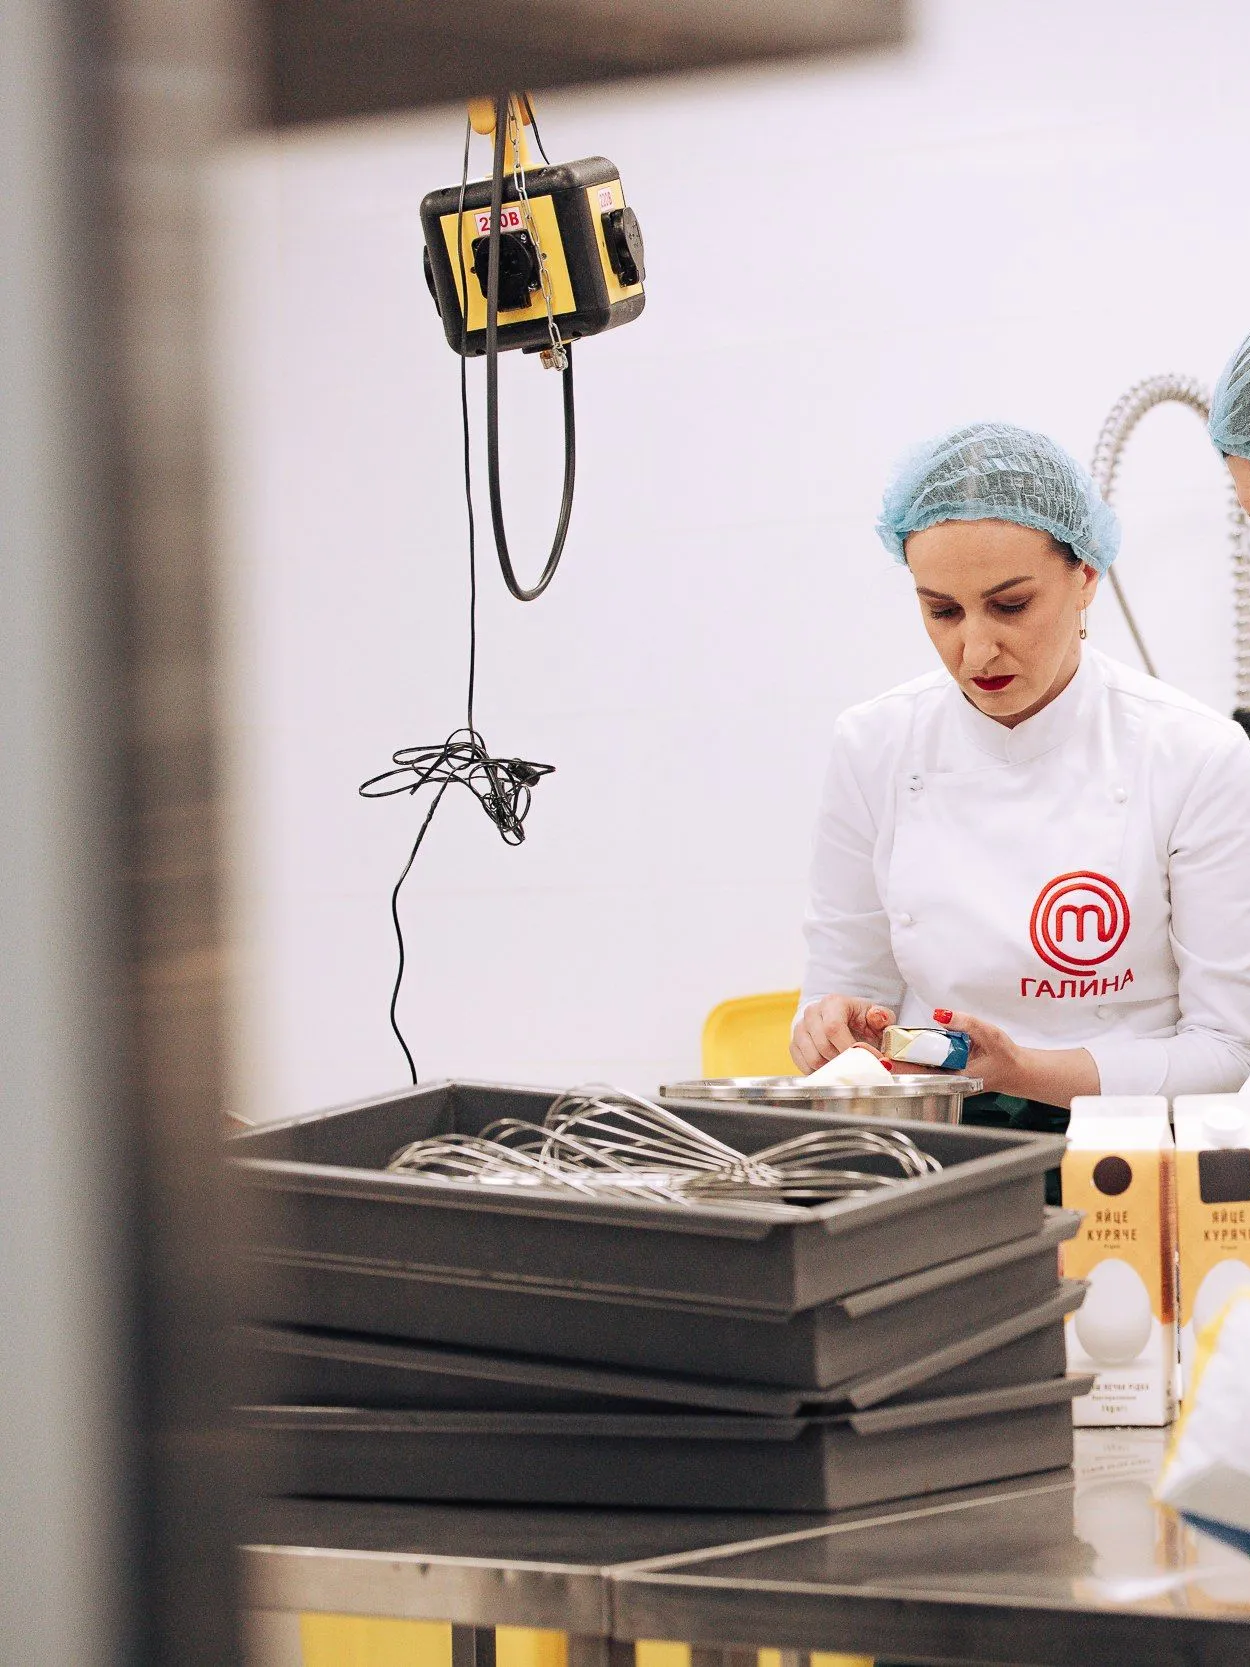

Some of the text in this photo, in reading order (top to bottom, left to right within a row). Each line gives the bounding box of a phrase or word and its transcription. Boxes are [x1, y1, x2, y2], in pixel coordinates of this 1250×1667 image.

[479, 211, 520, 232] 20В
[1020, 967, 1135, 999] ГАЛИНА
[1095, 1209, 1129, 1225] ЯЙЦЕ
[1211, 1209, 1246, 1225] ЯЙЦЕ
[1087, 1228, 1137, 1242] КУРЯЧЕ
